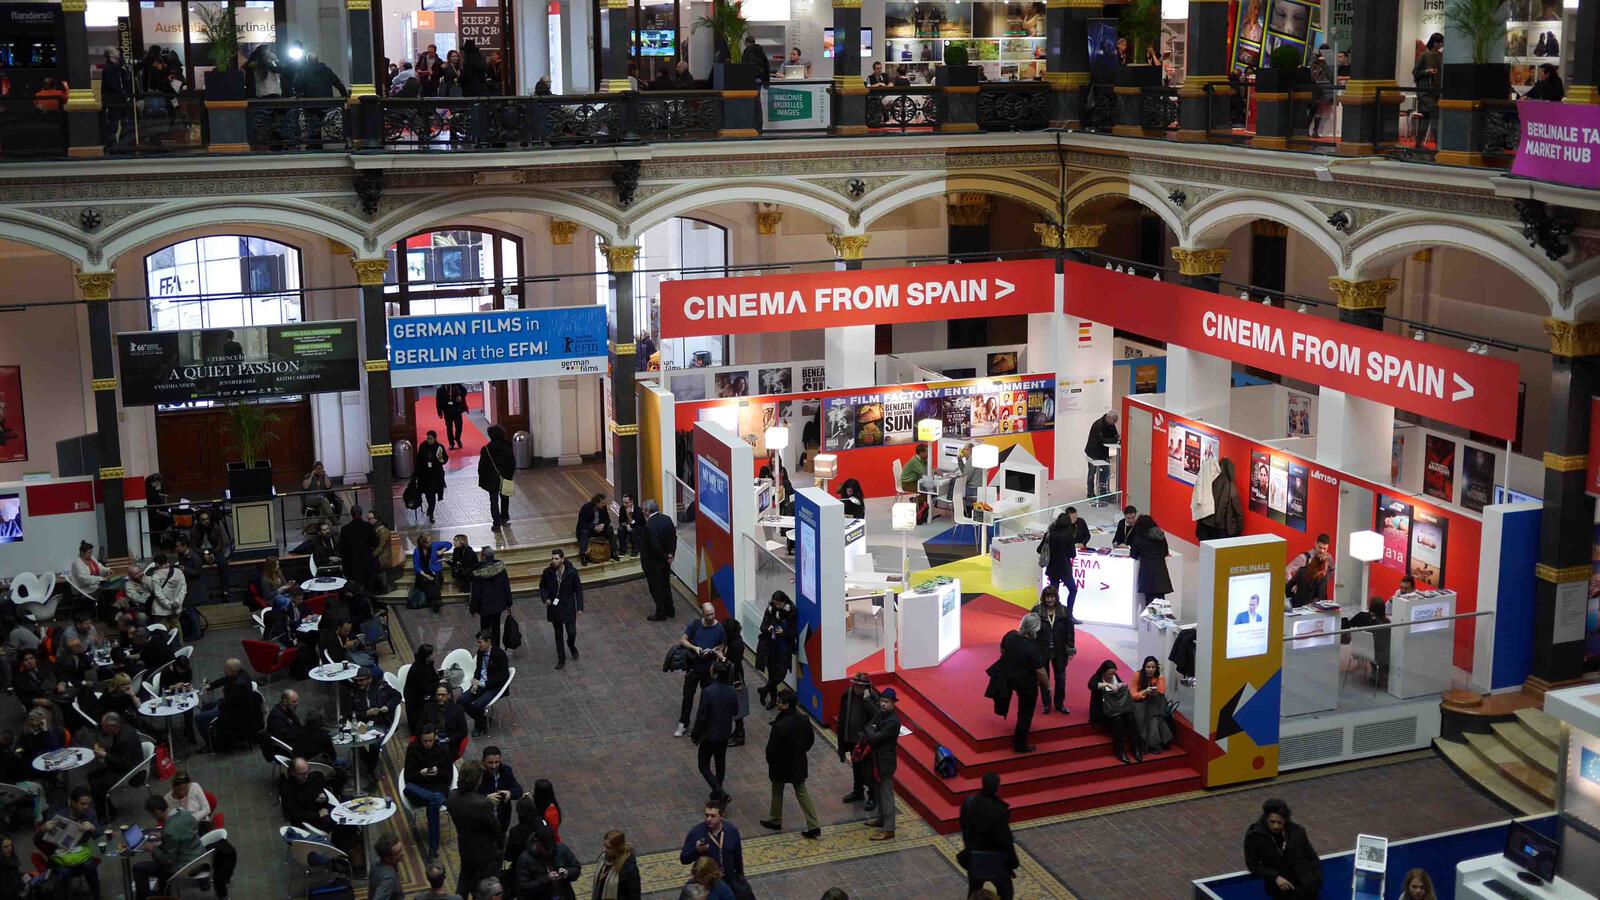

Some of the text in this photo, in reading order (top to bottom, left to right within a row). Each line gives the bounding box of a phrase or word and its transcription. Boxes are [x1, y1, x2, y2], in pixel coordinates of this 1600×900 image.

[1334, 0, 1352, 11] Iris
[462, 16, 490, 25] KEEP
[155, 22, 207, 32] Austalia
[462, 26, 500, 35] ON CR
[774, 101, 804, 109] BRUXELLES
[777, 108, 800, 116] IMAGES
[1527, 122, 1579, 143] BERLINALE
[1525, 140, 1591, 163] MARKET HUB
[159, 275, 182, 295] FFA
[683, 278, 987, 320] CINEMA FROM SPAIN
[393, 316, 540, 339] GERMAN FILMS in
[394, 340, 549, 365] BERLIN at the EFM!
[1202, 311, 1445, 399] CINEMA FROM SPAIN
[561, 359, 590, 368] german
[580, 365, 599, 373] films
[169, 360, 300, 380] A QUIET PASSION
[802, 367, 825, 378] BENEA
[850, 394, 880, 405] FILM
[883, 389, 940, 403] FACTORY
[944, 380, 1047, 397] ENTERTAINMENT
[884, 402, 913, 412] BENEATH
[885, 414, 913, 432] SUN
[1070, 558, 1101, 571] EMA
[1230, 562, 1271, 574] BERLINALE
